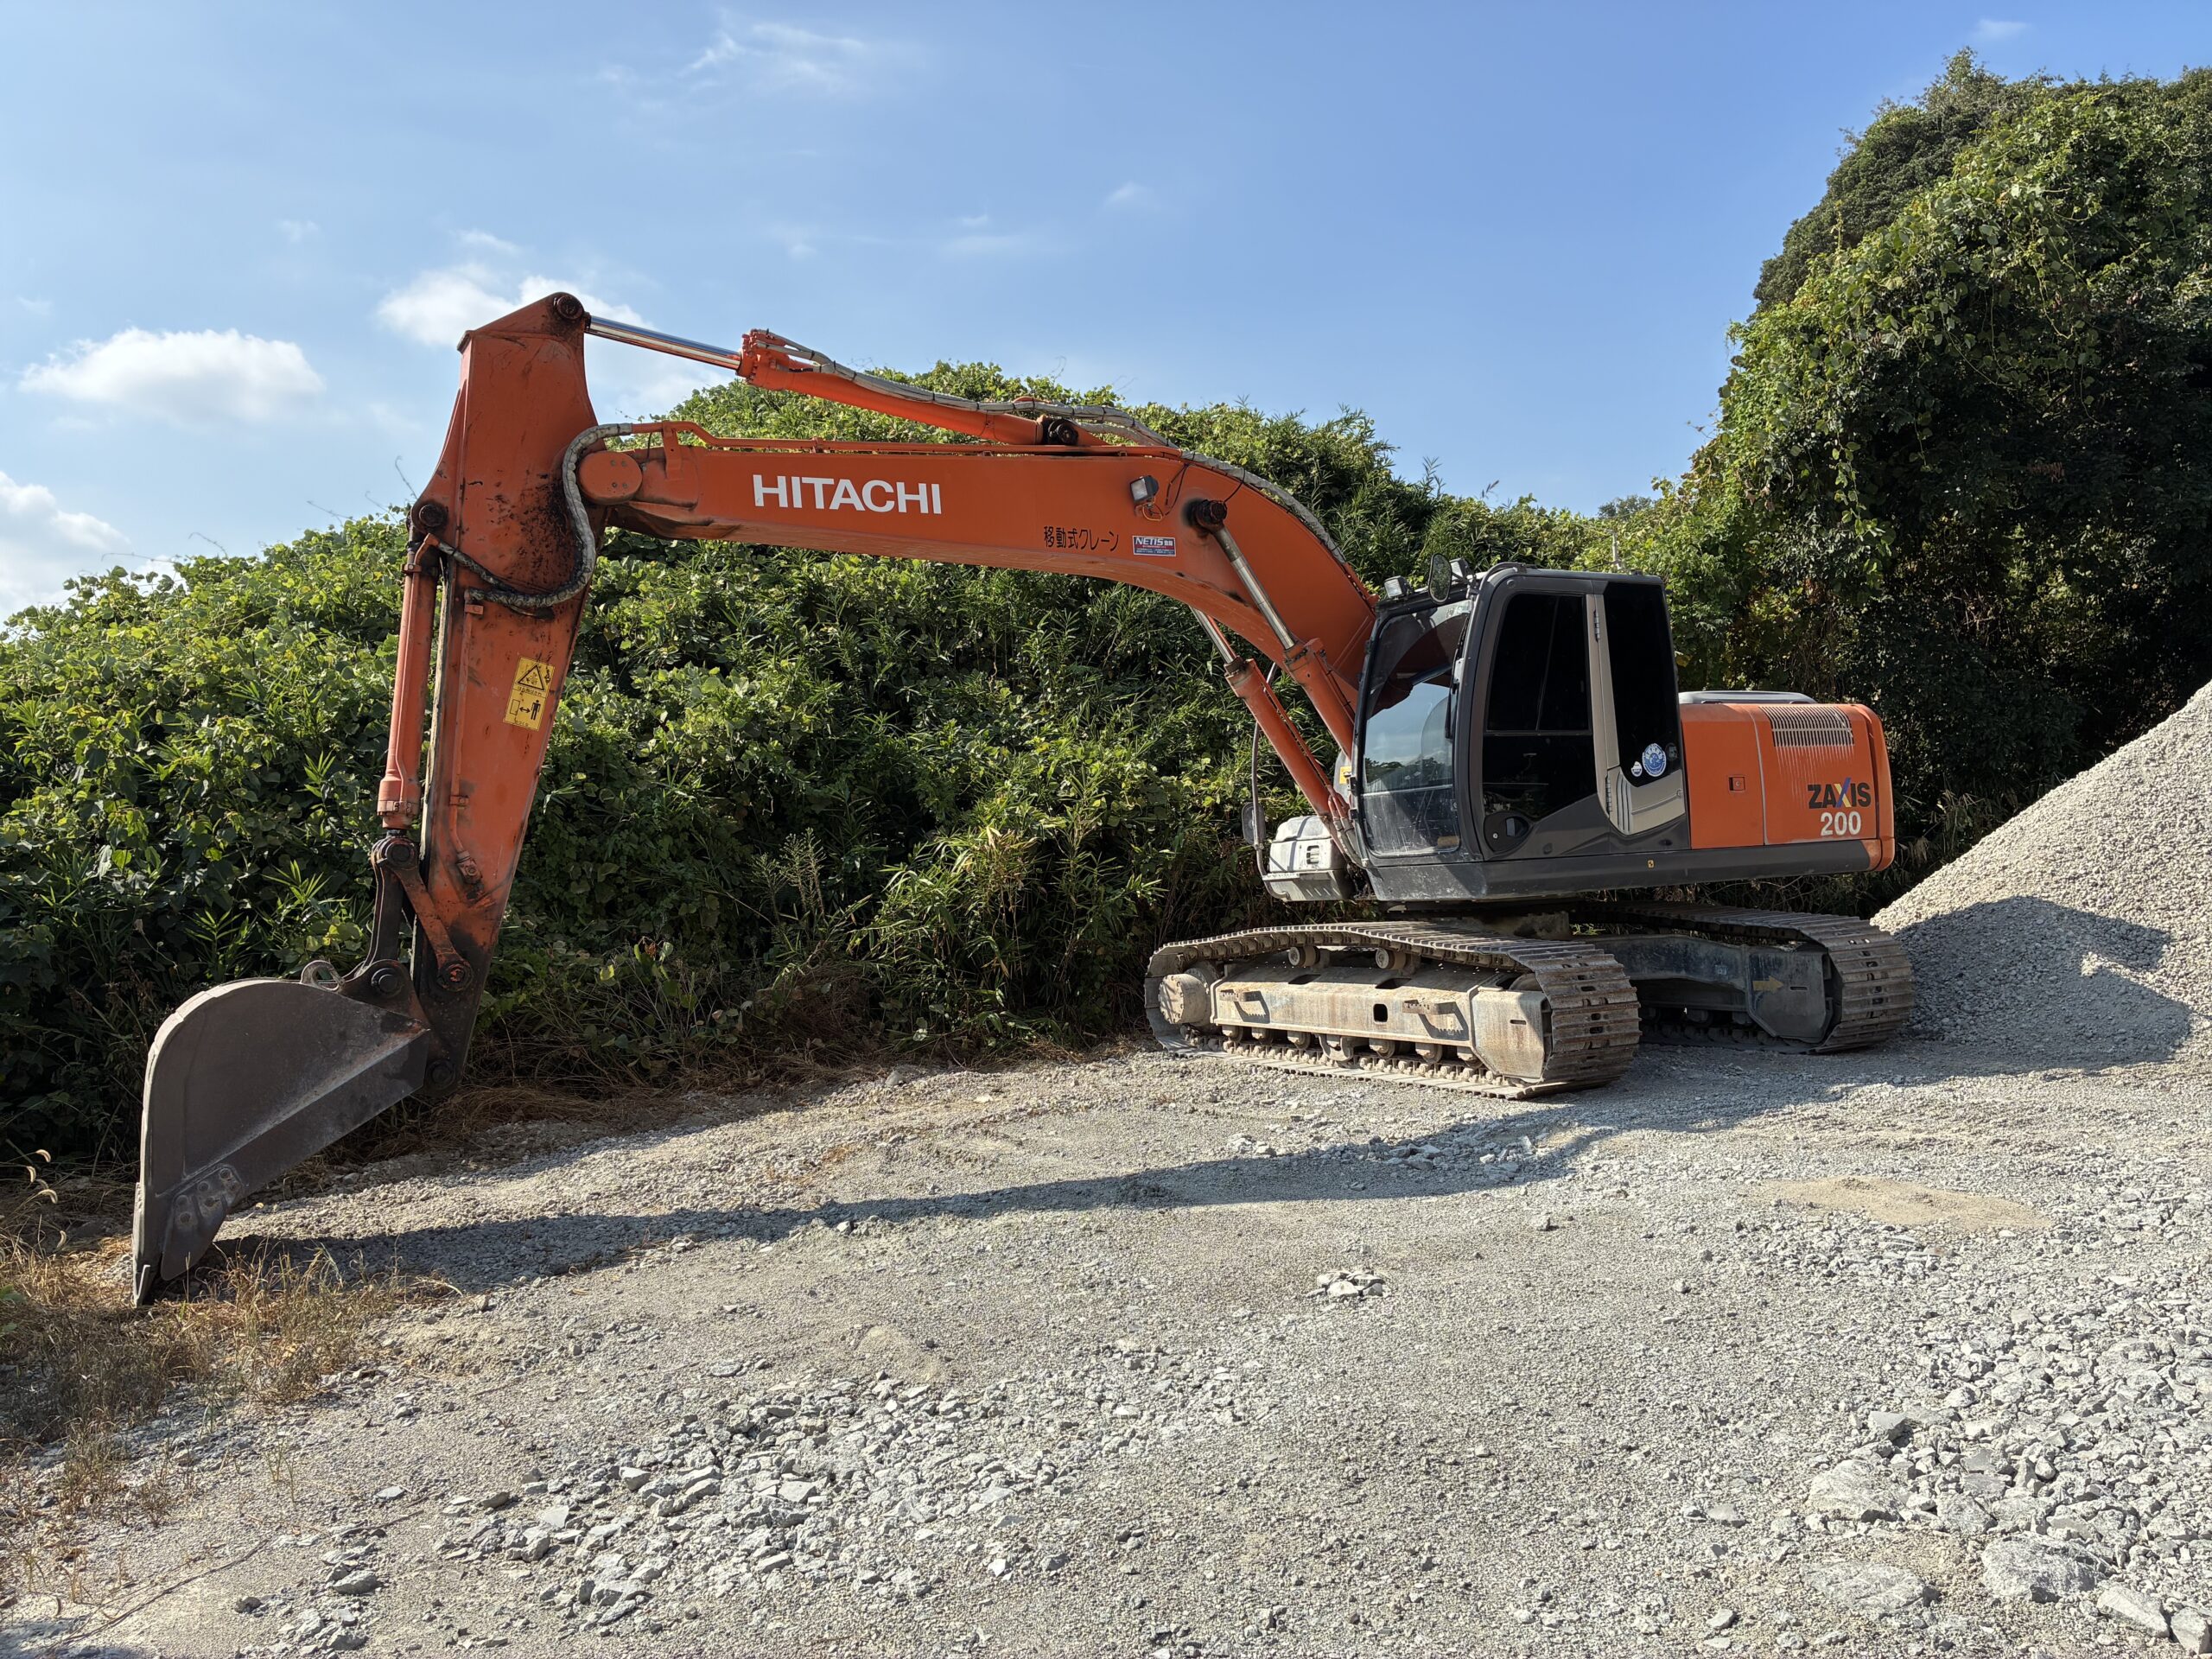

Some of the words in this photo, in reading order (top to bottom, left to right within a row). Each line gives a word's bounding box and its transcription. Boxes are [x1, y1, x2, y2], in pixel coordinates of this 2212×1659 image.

[753, 474, 942, 514] HITACHI
[1043, 525, 1119, 552] 移動式クレーン
[1807, 777, 1872, 810] ZAXIS
[1820, 810, 1861, 836] 200
